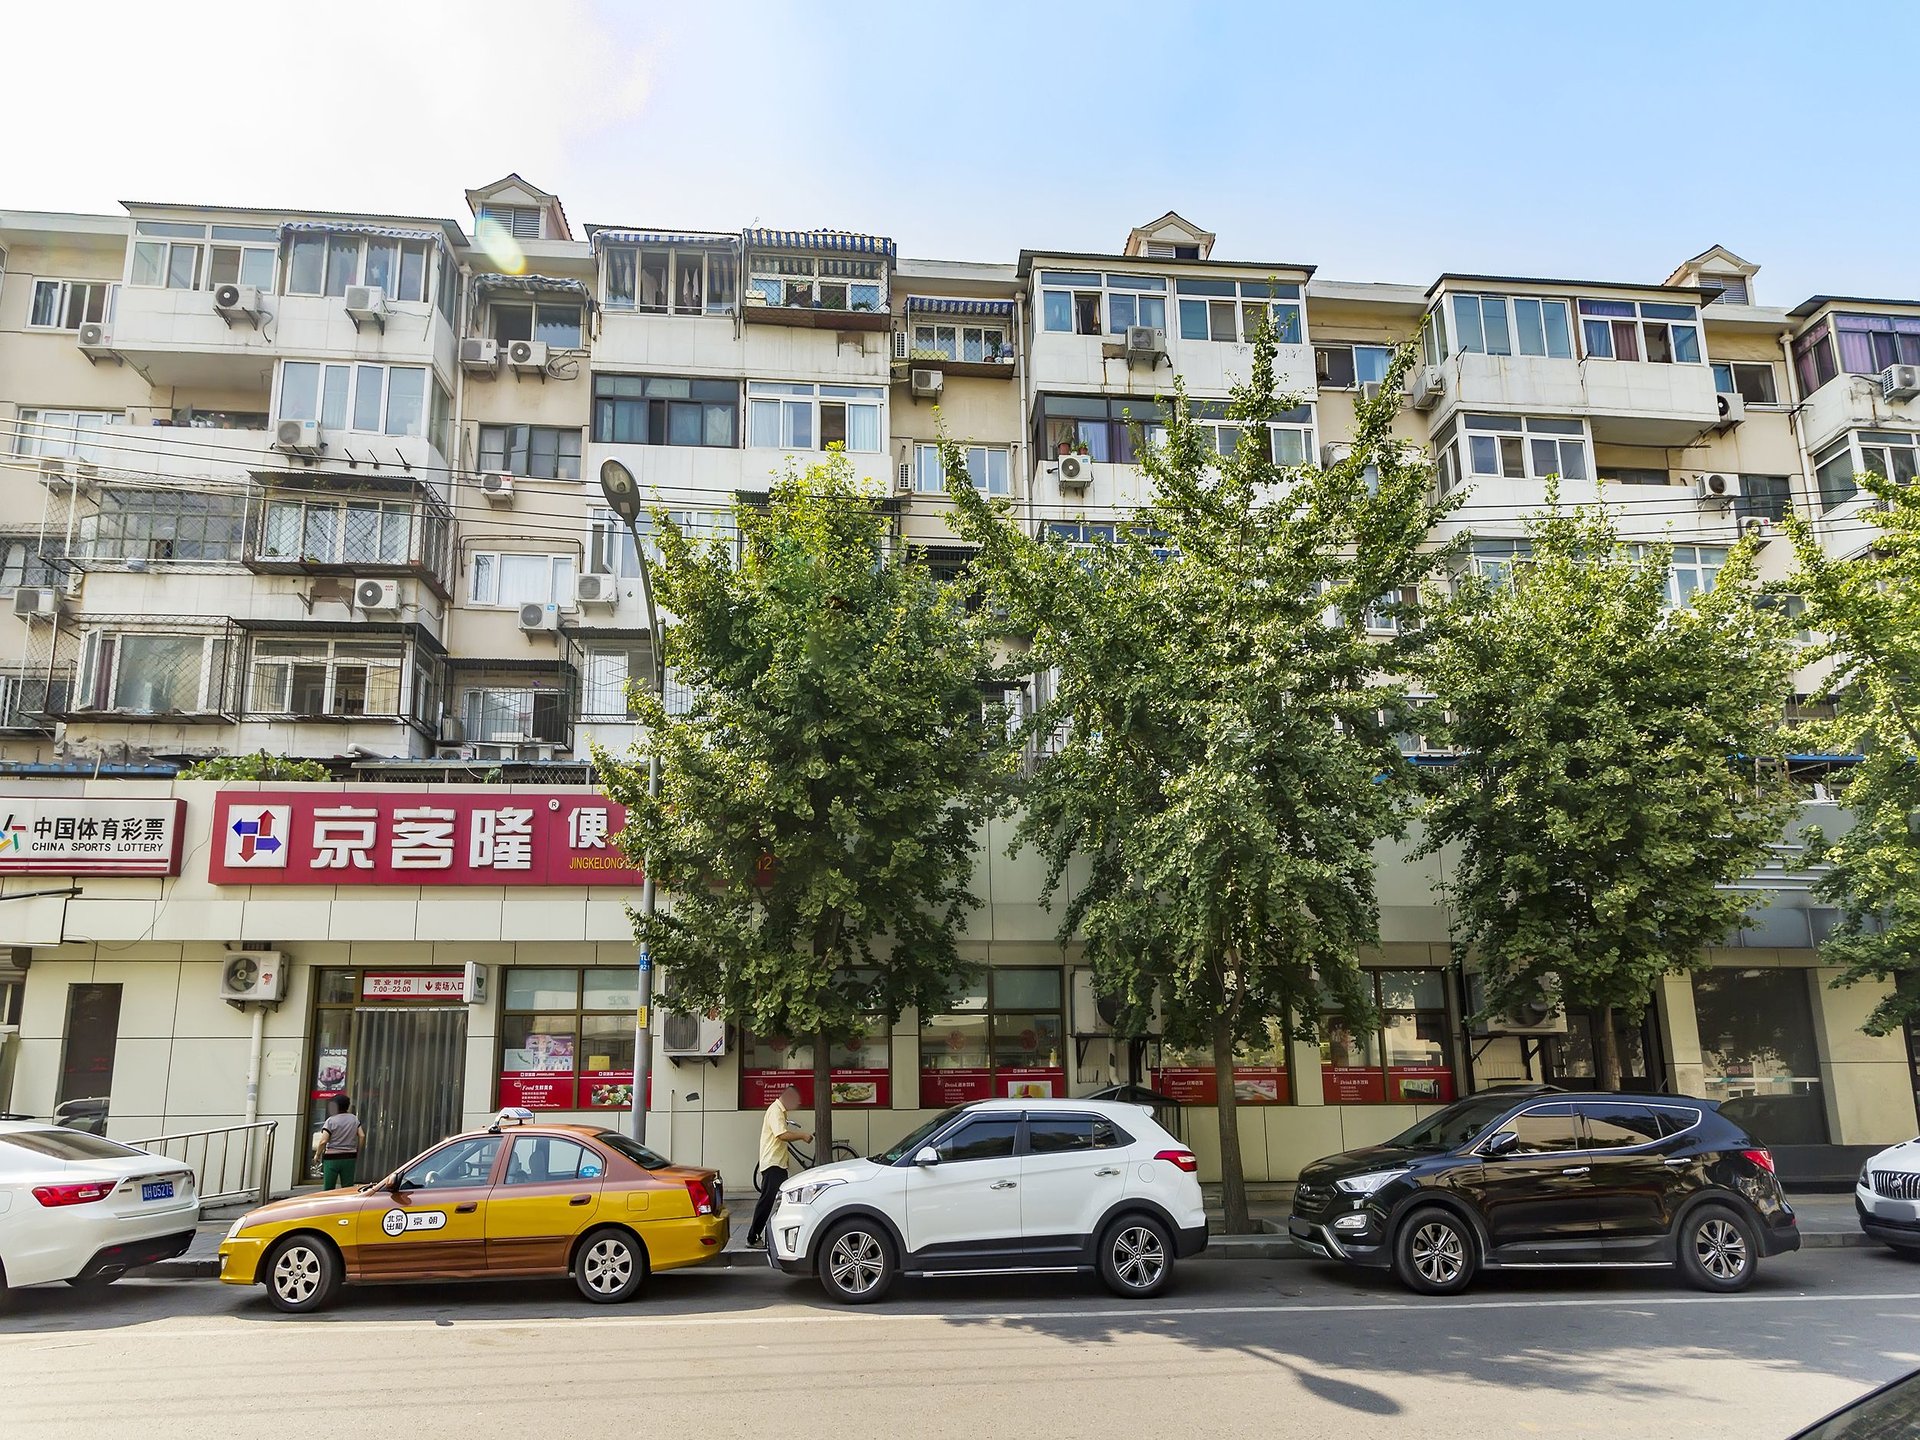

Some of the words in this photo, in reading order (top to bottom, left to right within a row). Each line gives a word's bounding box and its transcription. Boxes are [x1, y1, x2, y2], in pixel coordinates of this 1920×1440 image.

[33, 817, 165, 840] 中国体育彩票
[310, 805, 534, 869] 京客隆
[32, 842, 65, 851] CHINA
[71, 842, 112, 852] SPORTS
[117, 843, 164, 852] LOTTERY
[434, 981, 465, 991] 卖场入口
[386, 1223, 403, 1231] 出租
